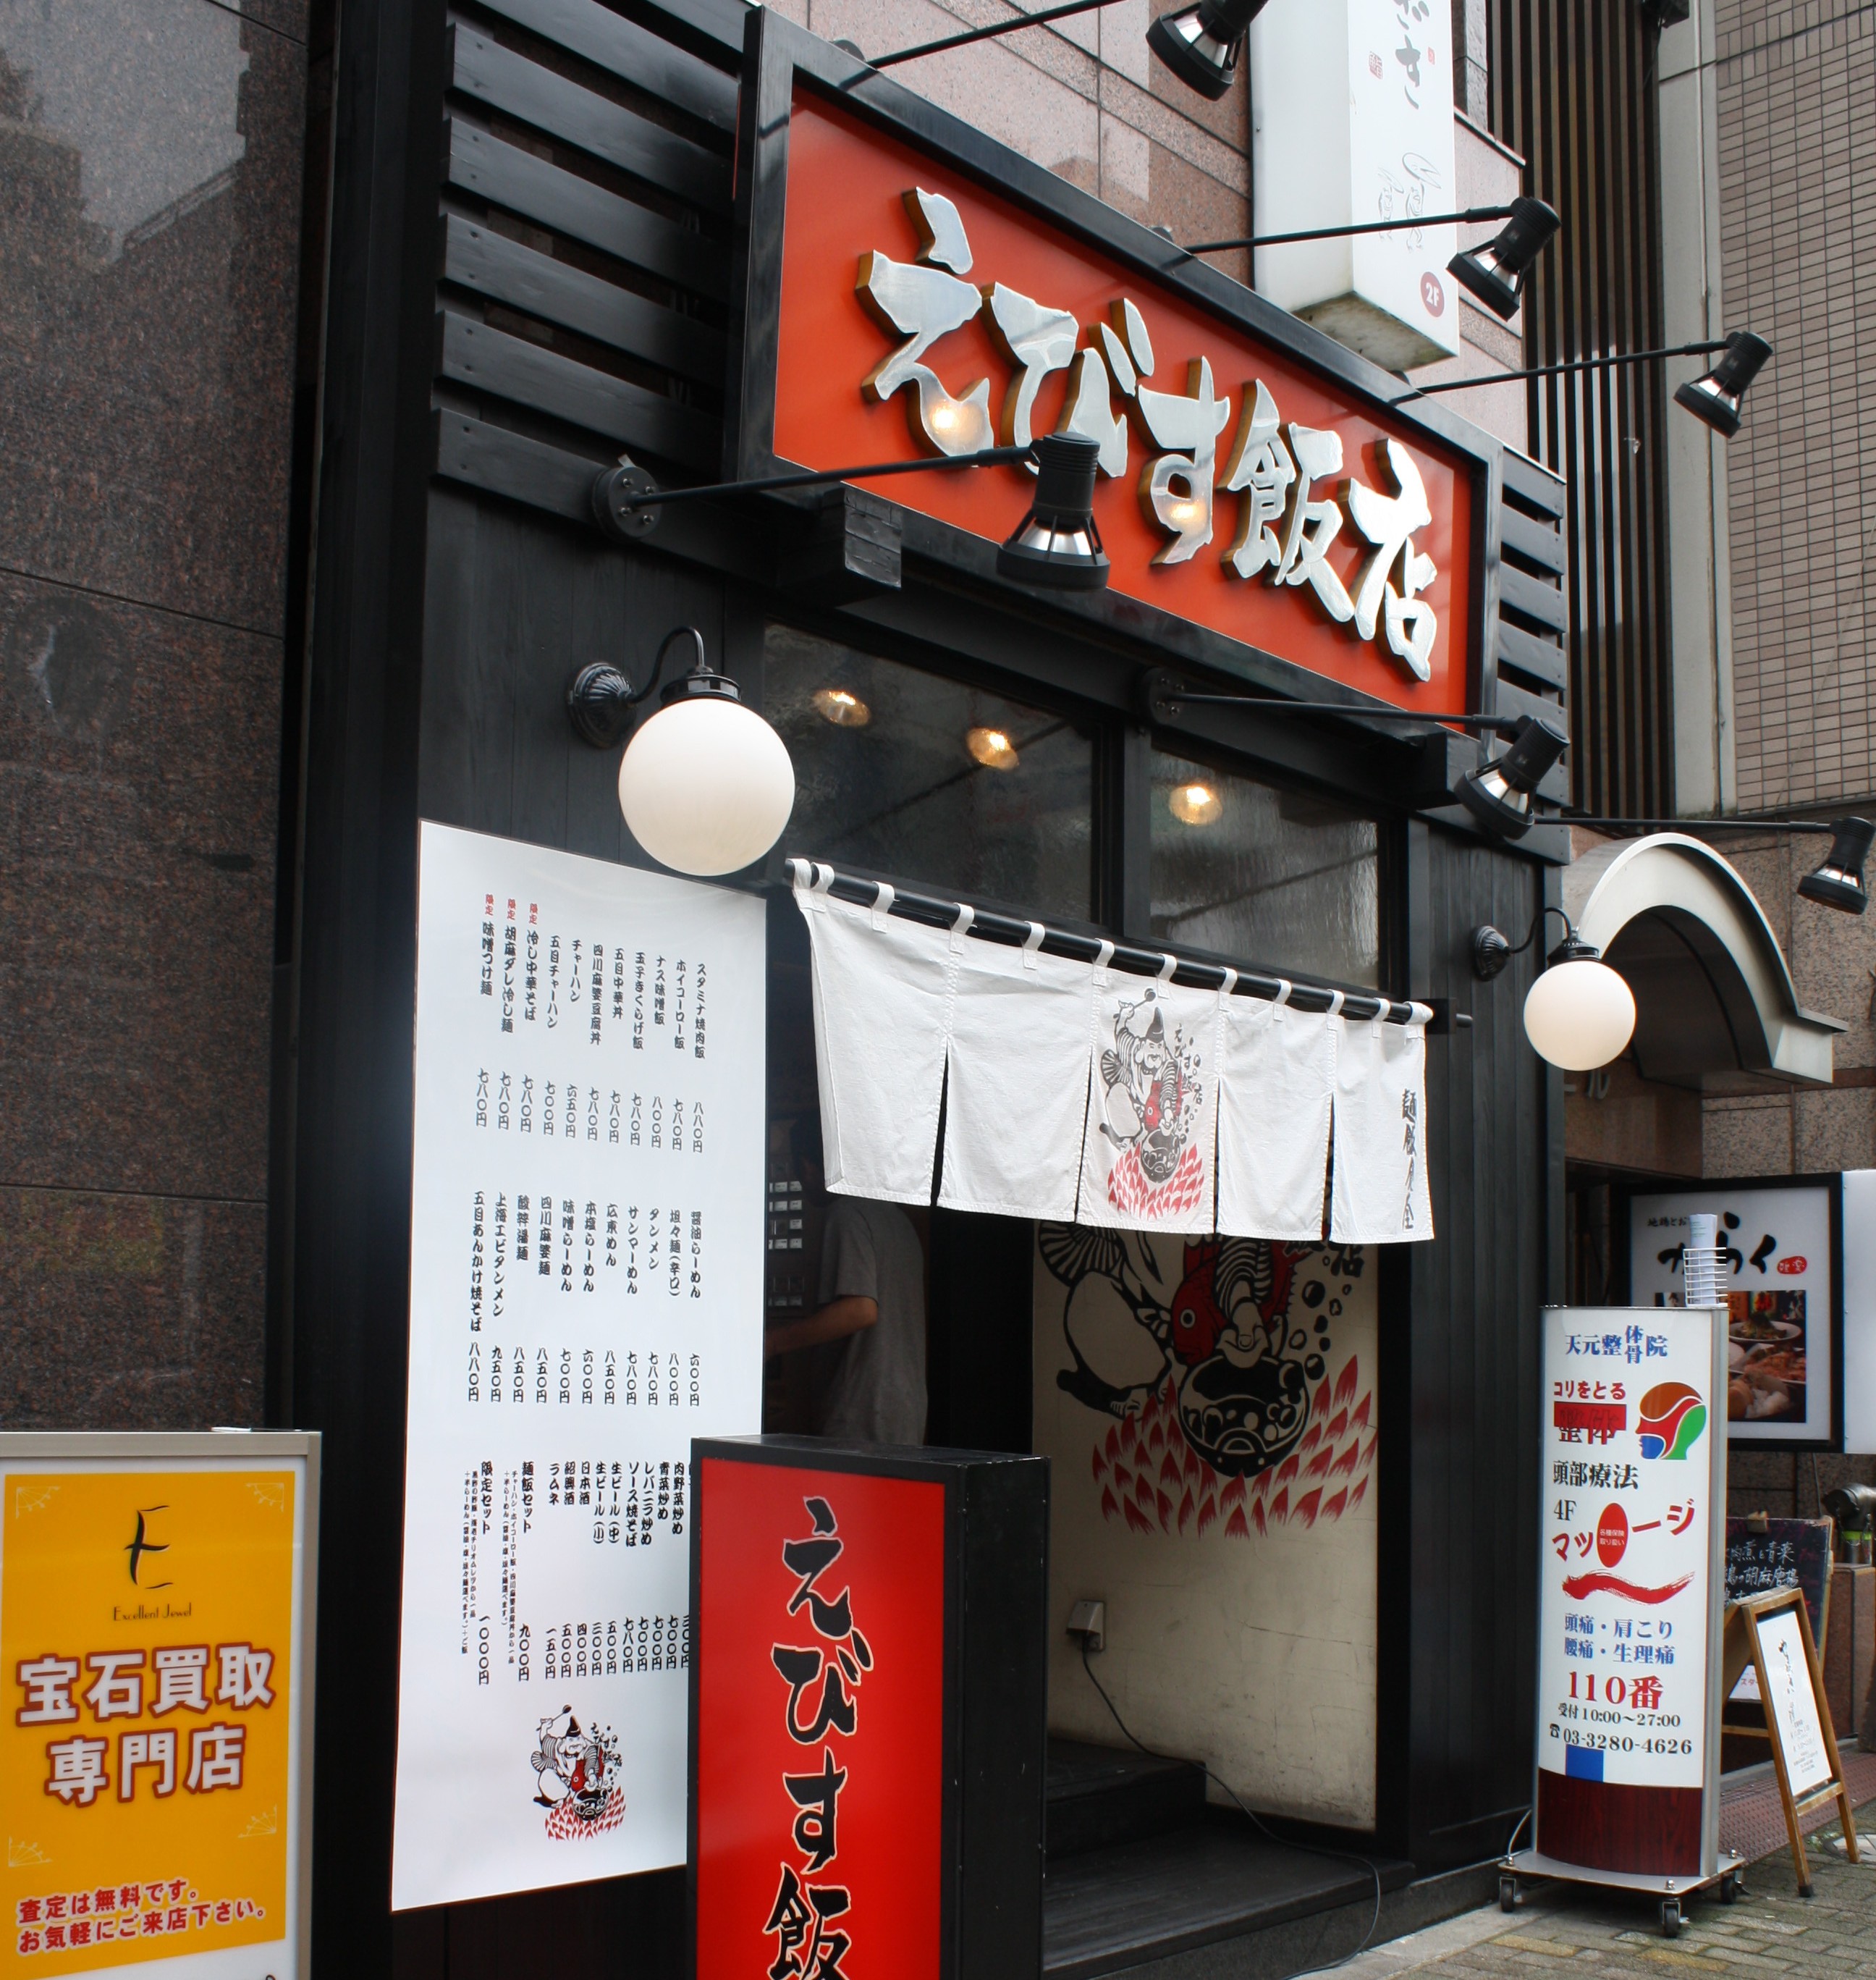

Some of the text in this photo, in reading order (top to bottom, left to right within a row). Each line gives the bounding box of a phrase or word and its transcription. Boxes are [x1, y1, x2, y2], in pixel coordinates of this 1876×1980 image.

[1425, 282, 1440, 307] 2F
[856, 187, 1437, 682] えびす飯店
[480, 921, 495, 996] 味噌つけ麺
[524, 930, 539, 1021] 冷し中華そば
[547, 935, 561, 1029] 五目チャーハン
[570, 939, 583, 1003] チャーハン
[590, 944, 604, 1045] 四川麻婆豆腐丼
[612, 948, 625, 1020] 五目中華丼
[654, 955, 667, 1026] ナス味噌飯
[674, 959, 686, 1050] ホイコーロー飯
[694, 963, 707, 1059] スタミナ焼肉飯
[1174, 1022, 1203, 1105] えびす飯店
[470, 1190, 485, 1332] 五目あんかけ焼そば
[492, 1192, 507, 1318] 上海エビタンメン
[538, 1196, 552, 1276] 四川麻婆麺
[560, 1199, 575, 1292] 味噌らーめん
[583, 1200, 597, 1293] 本塩らーめん
[605, 1203, 618, 1267] 広東めん
[626, 1205, 639, 1294] サンマーめん
[648, 1208, 660, 1271] タンメン
[690, 1210, 702, 1299] 醤油らーめん
[1554, 1381, 1626, 1400] コリをとる
[480, 1460, 494, 1535] 限定セット
[521, 1460, 534, 1534] 麺飯セット
[548, 1462, 560, 1506] ラムネ
[563, 1460, 576, 1506] 紹興酒
[578, 1460, 591, 1506] 日本酒
[625, 1461, 640, 1548] ソース焼そば
[640, 1461, 656, 1546] レバニラ炒め
[656, 1461, 671, 1520] 青菜炒め
[672, 1461, 684, 1535] 肉野菜炒め
[1553, 1459, 1639, 1489] 頭部療法
[1553, 1499, 1576, 1521] 4F
[113, 1601, 193, 1622] Excellent Jewel
[1564, 1613, 1674, 1640] 頭痛・肩こり
[17, 1643, 275, 1727] 宝石買取
[1564, 1636, 1676, 1665] 腰痛・生理痛
[1569, 1671, 1664, 1710] 110番
[46, 1723, 245, 1808] 専門店
[762, 1496, 874, 1980] えびす飯
[1563, 1728, 1693, 1756] 03-3280-4626
[19, 1879, 198, 1924] 査定は無料です。
[19, 1900, 265, 1954] お気軽にご来店下さい。
